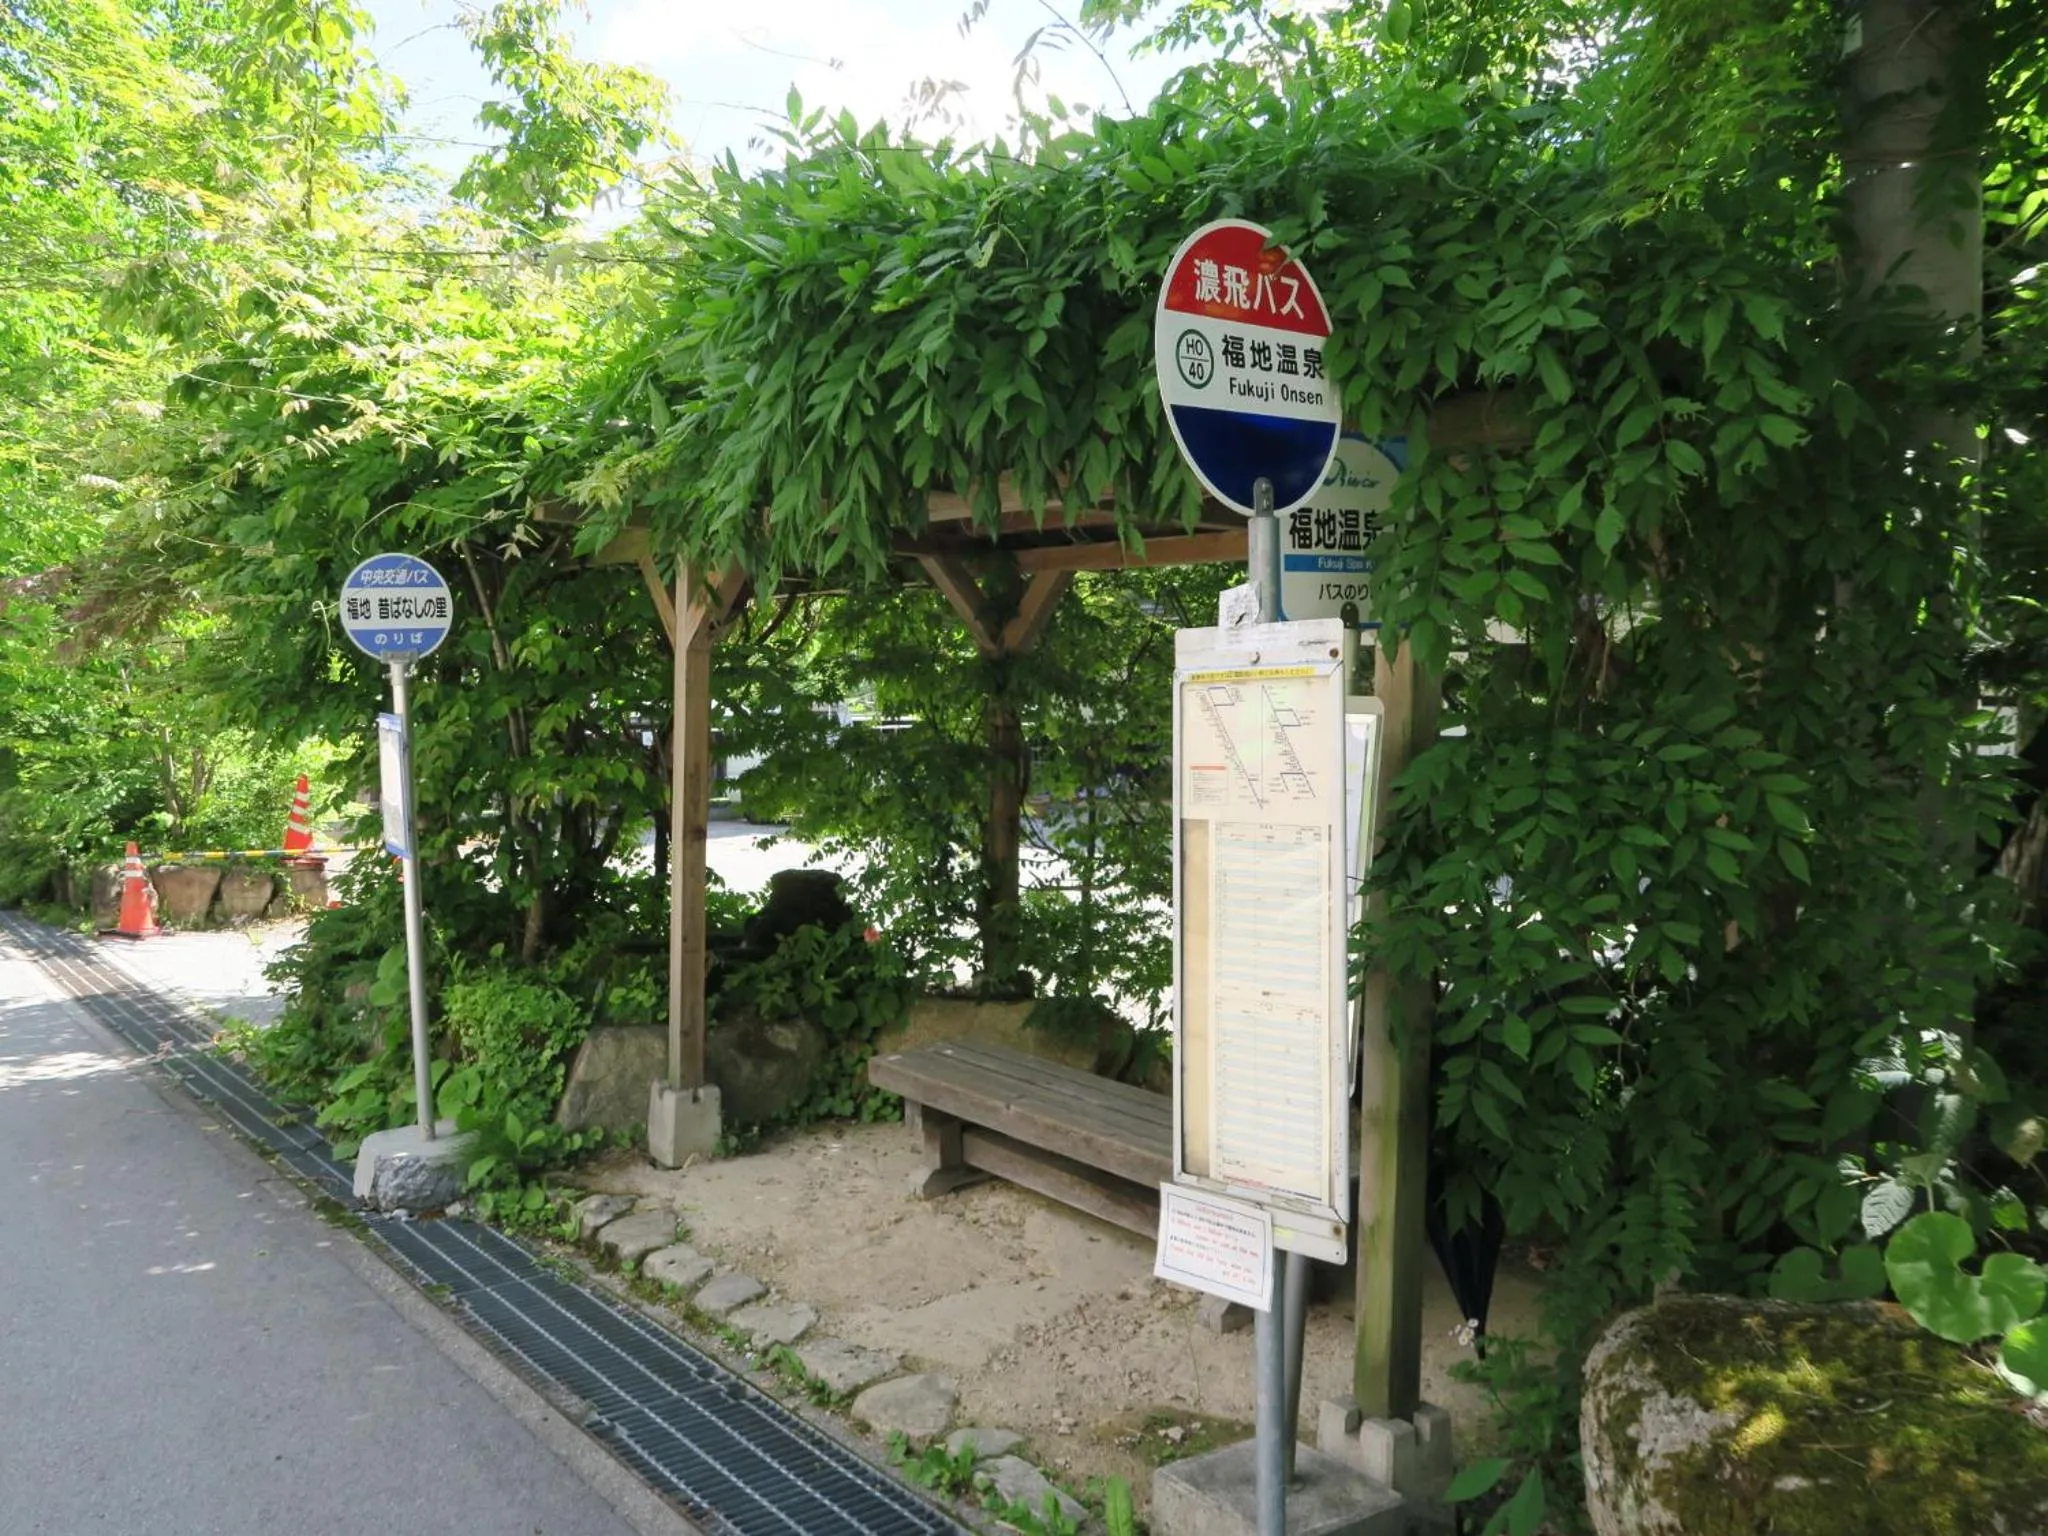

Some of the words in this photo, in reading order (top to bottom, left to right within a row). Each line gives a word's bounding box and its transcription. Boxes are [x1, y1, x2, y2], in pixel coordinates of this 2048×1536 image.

[1194, 259, 1305, 320] 濃飛バス
[1221, 333, 1325, 380] 福地温泉
[1188, 361, 1205, 381] 40
[1229, 376, 1275, 403] Fukuji
[1280, 383, 1323, 406] Onsen
[360, 568, 429, 585] 中央交通バス
[1318, 583, 1374, 601] バスのり
[374, 632, 424, 646] のりば
